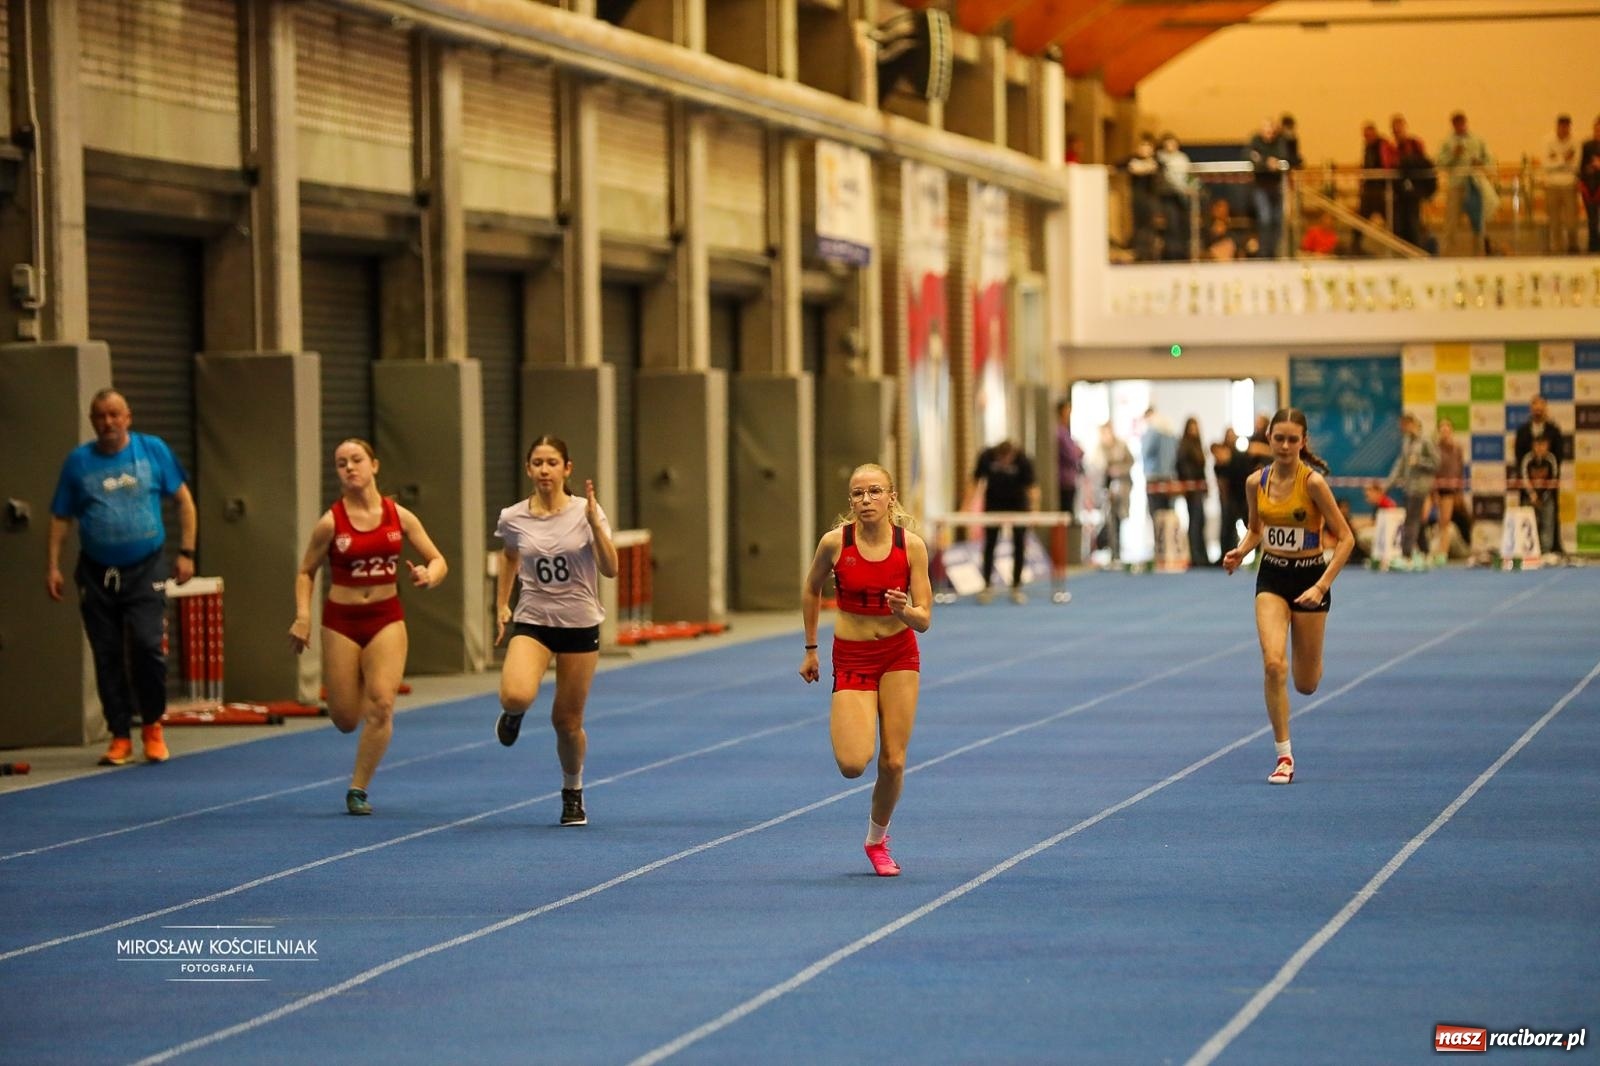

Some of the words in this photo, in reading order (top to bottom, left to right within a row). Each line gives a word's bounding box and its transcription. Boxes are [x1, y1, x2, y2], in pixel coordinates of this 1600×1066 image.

[1268, 528, 1296, 547] 604
[351, 555, 399, 577] 225
[536, 556, 569, 583] 68
[1264, 553, 1289, 567] PRO
